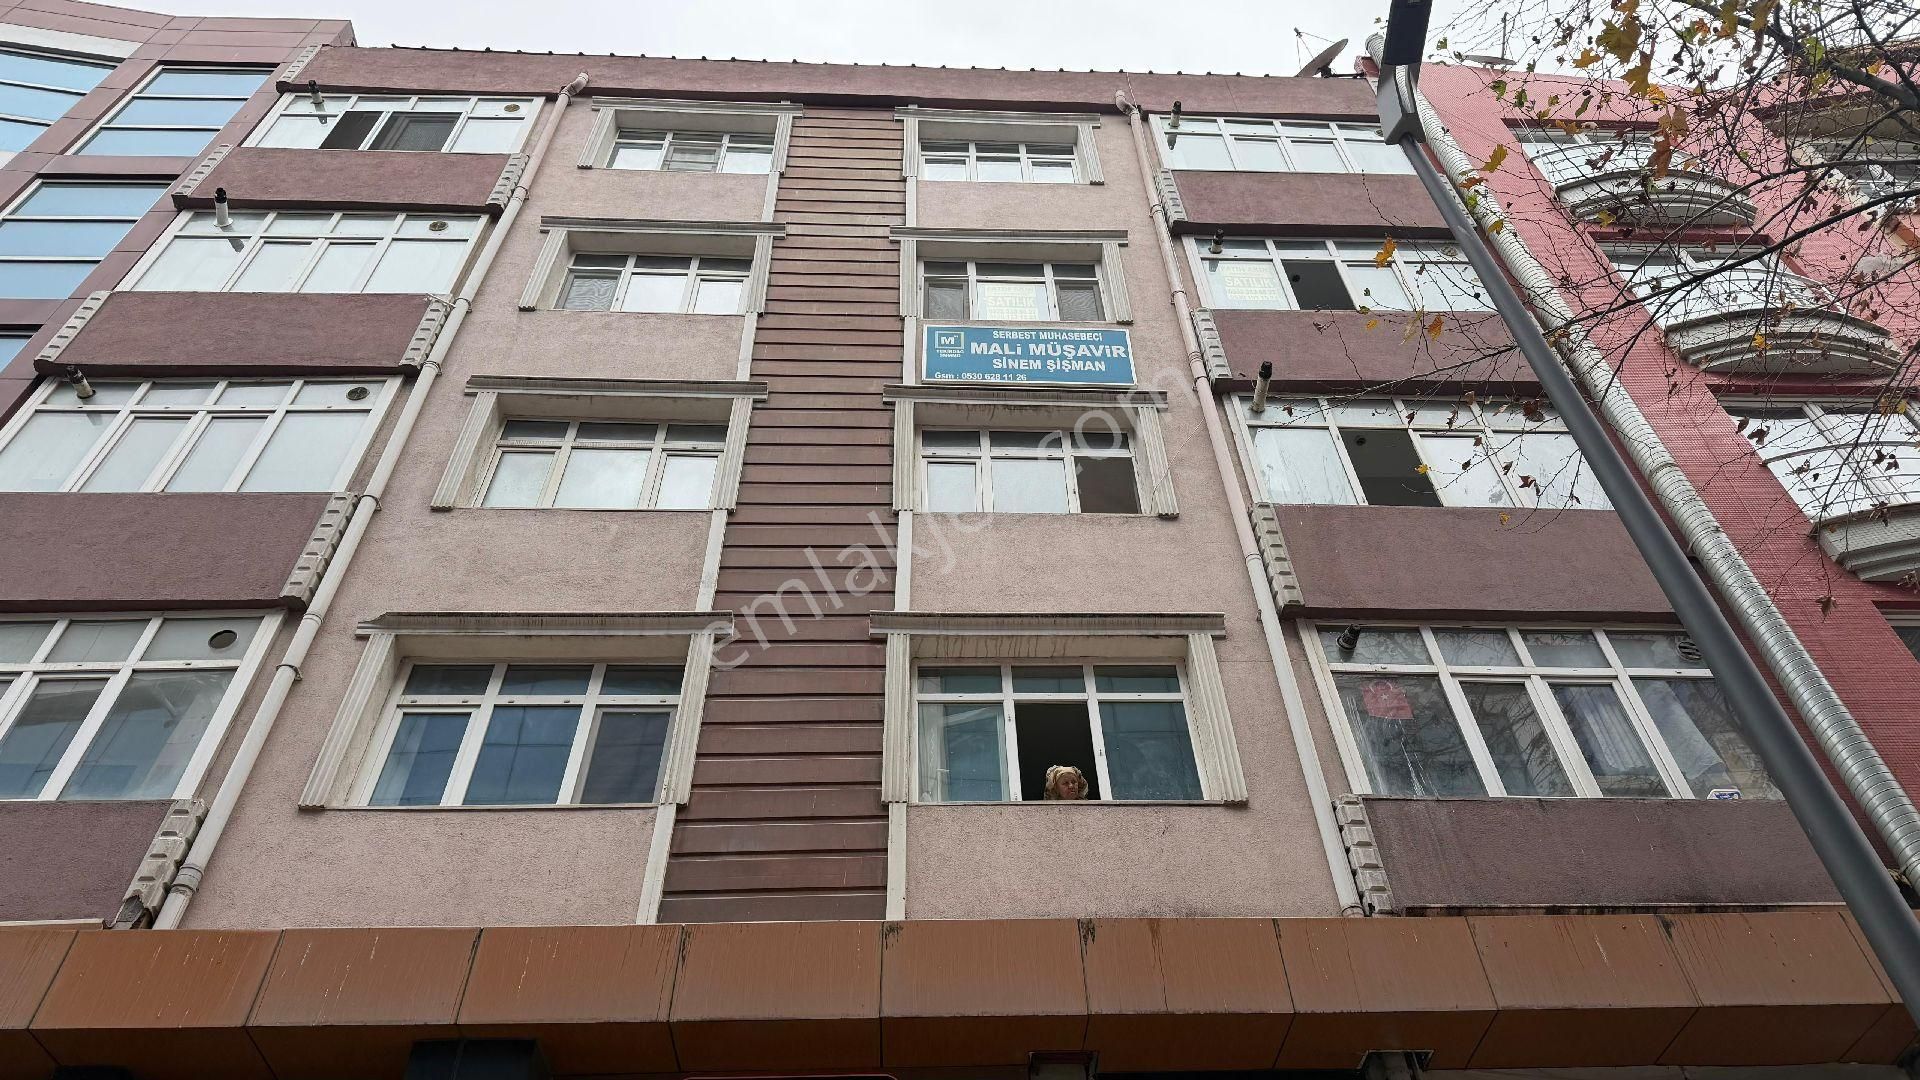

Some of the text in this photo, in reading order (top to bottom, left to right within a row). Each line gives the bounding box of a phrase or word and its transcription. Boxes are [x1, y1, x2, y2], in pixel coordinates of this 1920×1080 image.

[1225, 277, 1274, 288] SATILIK
[986, 296, 1036, 307] SATILIK
[992, 331, 1037, 340] SERBEST
[992, 356, 1106, 372] SİNEM ŞİŞMAN
[934, 371, 955, 380] Gsm
[961, 372, 983, 380] 0530
[984, 373, 1001, 381] 628
[1003, 373, 1013, 381] 11
[1016, 373, 1027, 381] 26
